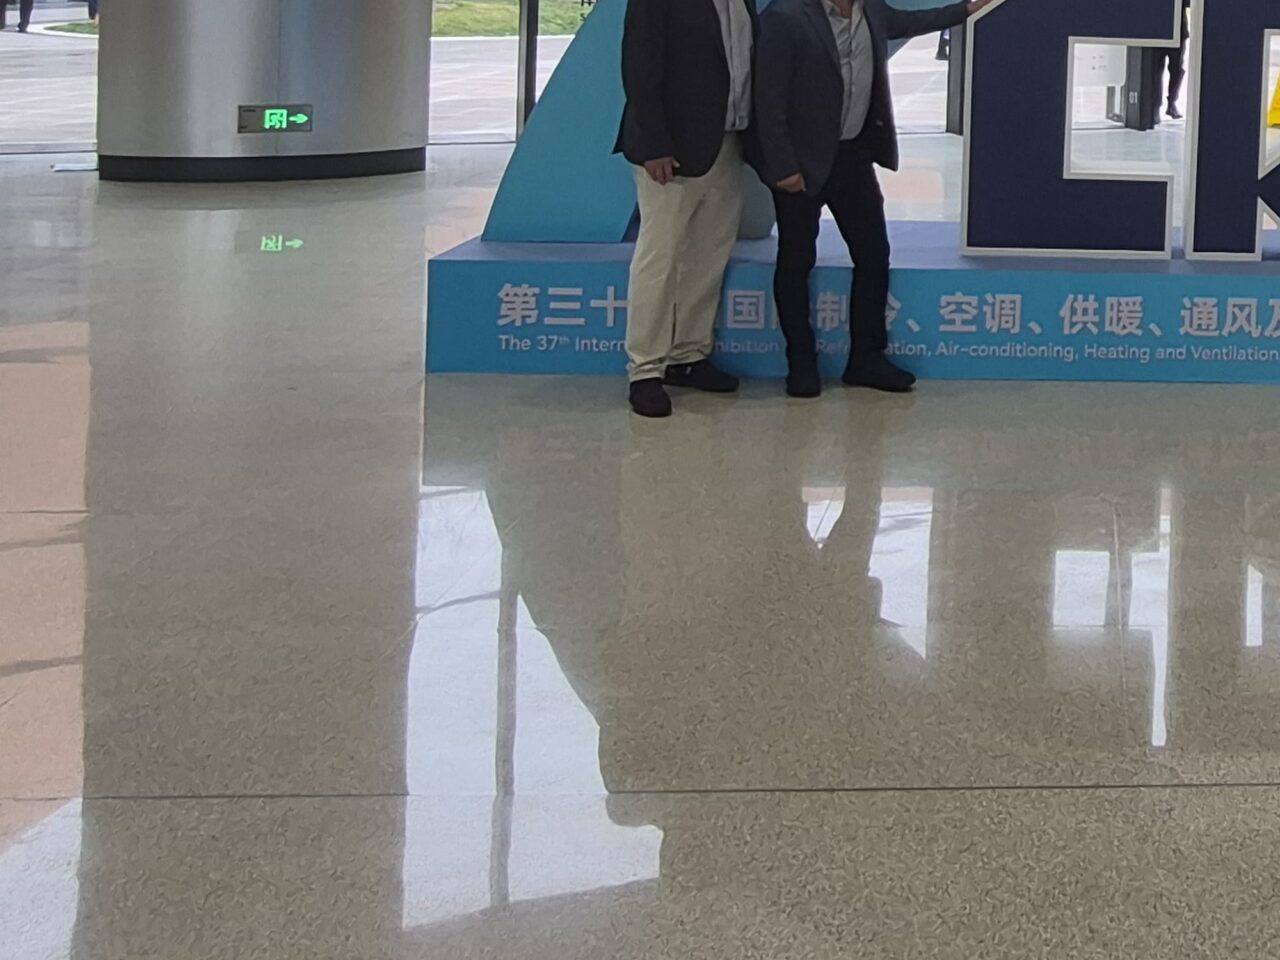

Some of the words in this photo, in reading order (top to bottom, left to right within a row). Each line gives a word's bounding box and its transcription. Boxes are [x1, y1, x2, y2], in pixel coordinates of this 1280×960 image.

[497, 334, 532, 352] The
[537, 334, 571, 352] 37th
[714, 339, 779, 354] hibition
[936, 342, 1078, 361] Air-conditioning,
[1084, 344, 1150, 362] Heating
[1155, 345, 1187, 360] and
